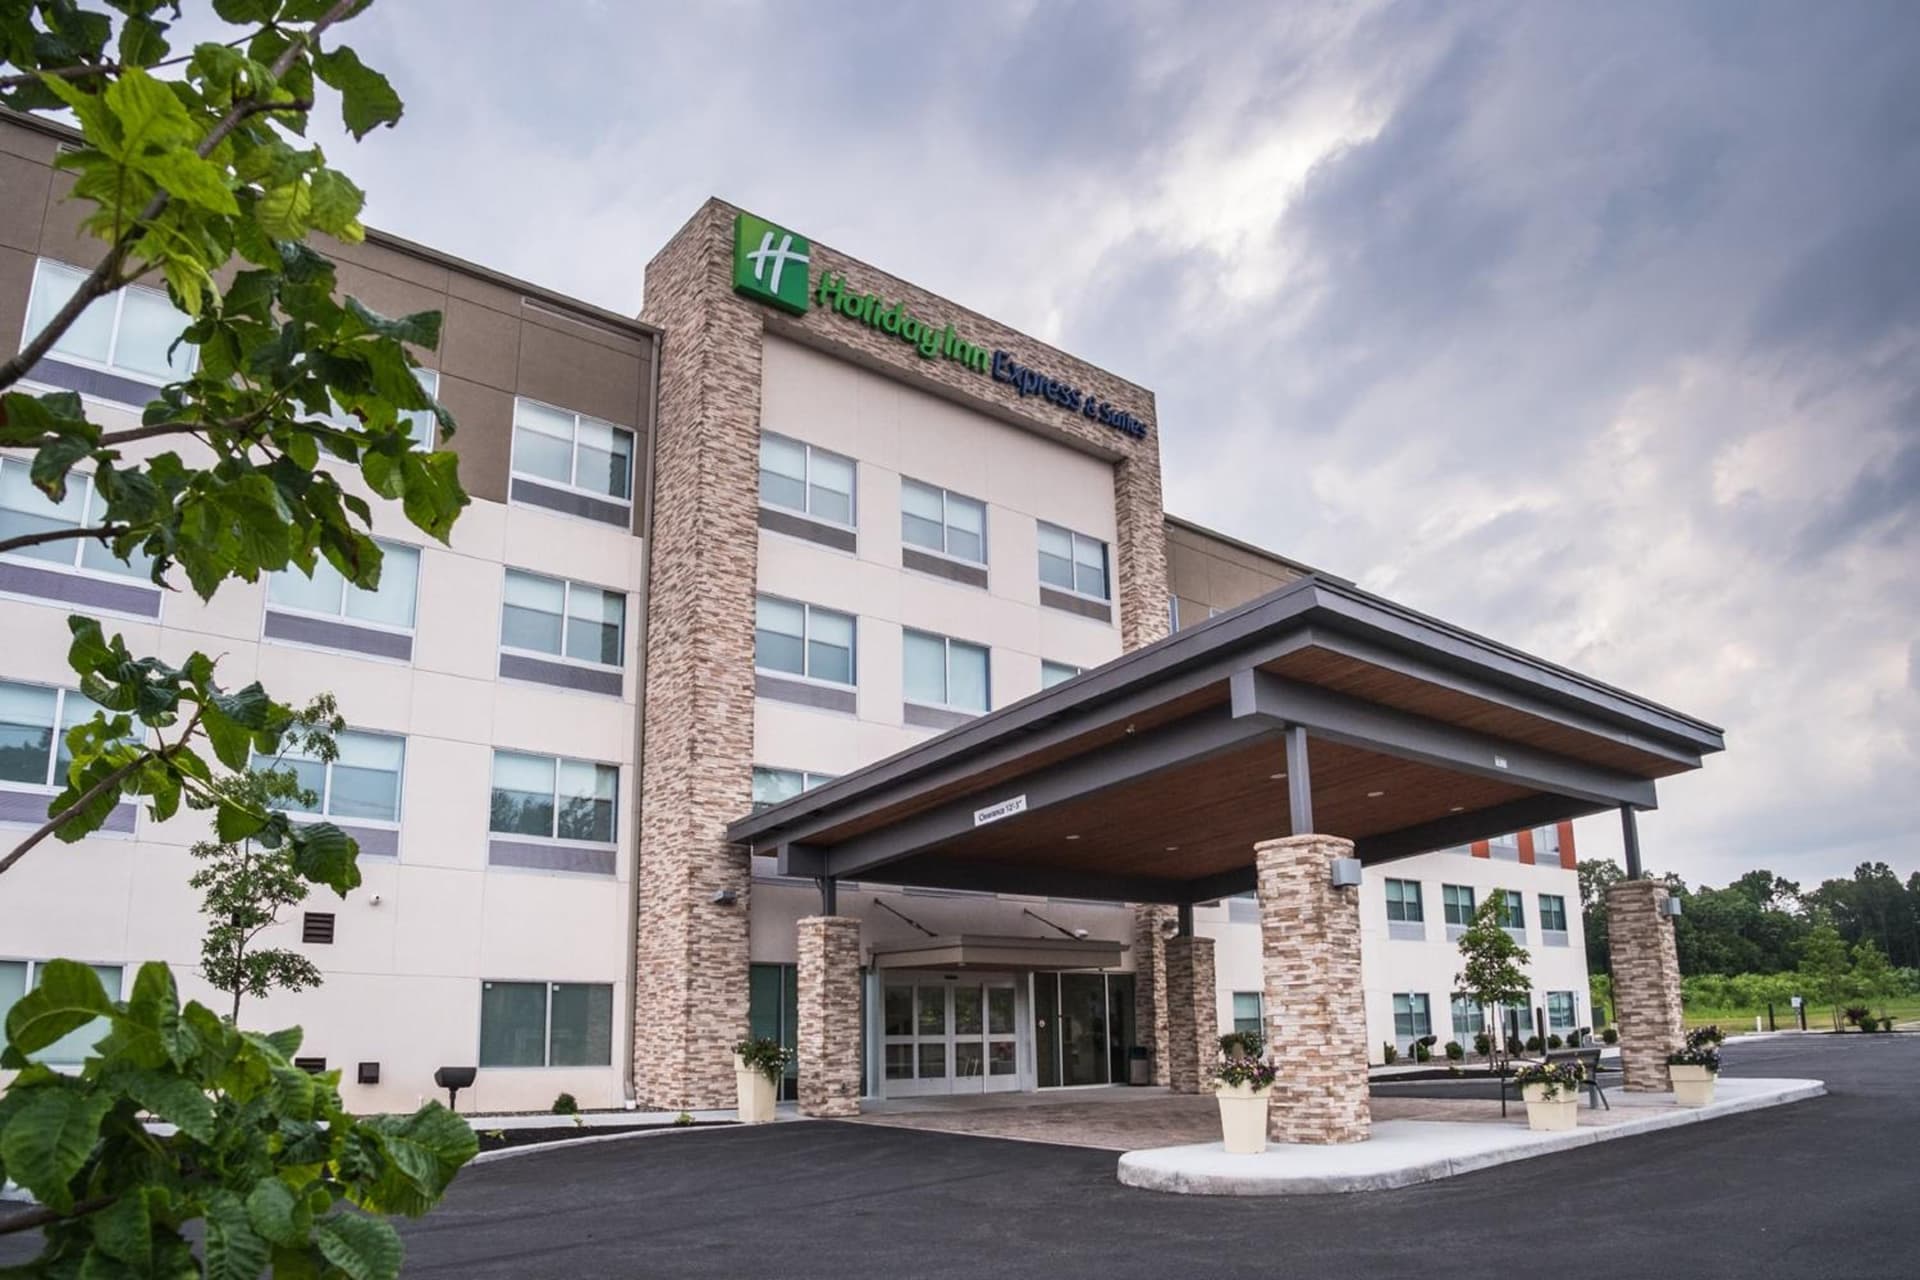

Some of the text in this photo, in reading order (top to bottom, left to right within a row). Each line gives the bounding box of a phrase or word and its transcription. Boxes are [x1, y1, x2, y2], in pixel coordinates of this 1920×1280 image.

[816, 270, 1147, 439] Holiday Inn Express & Suites
